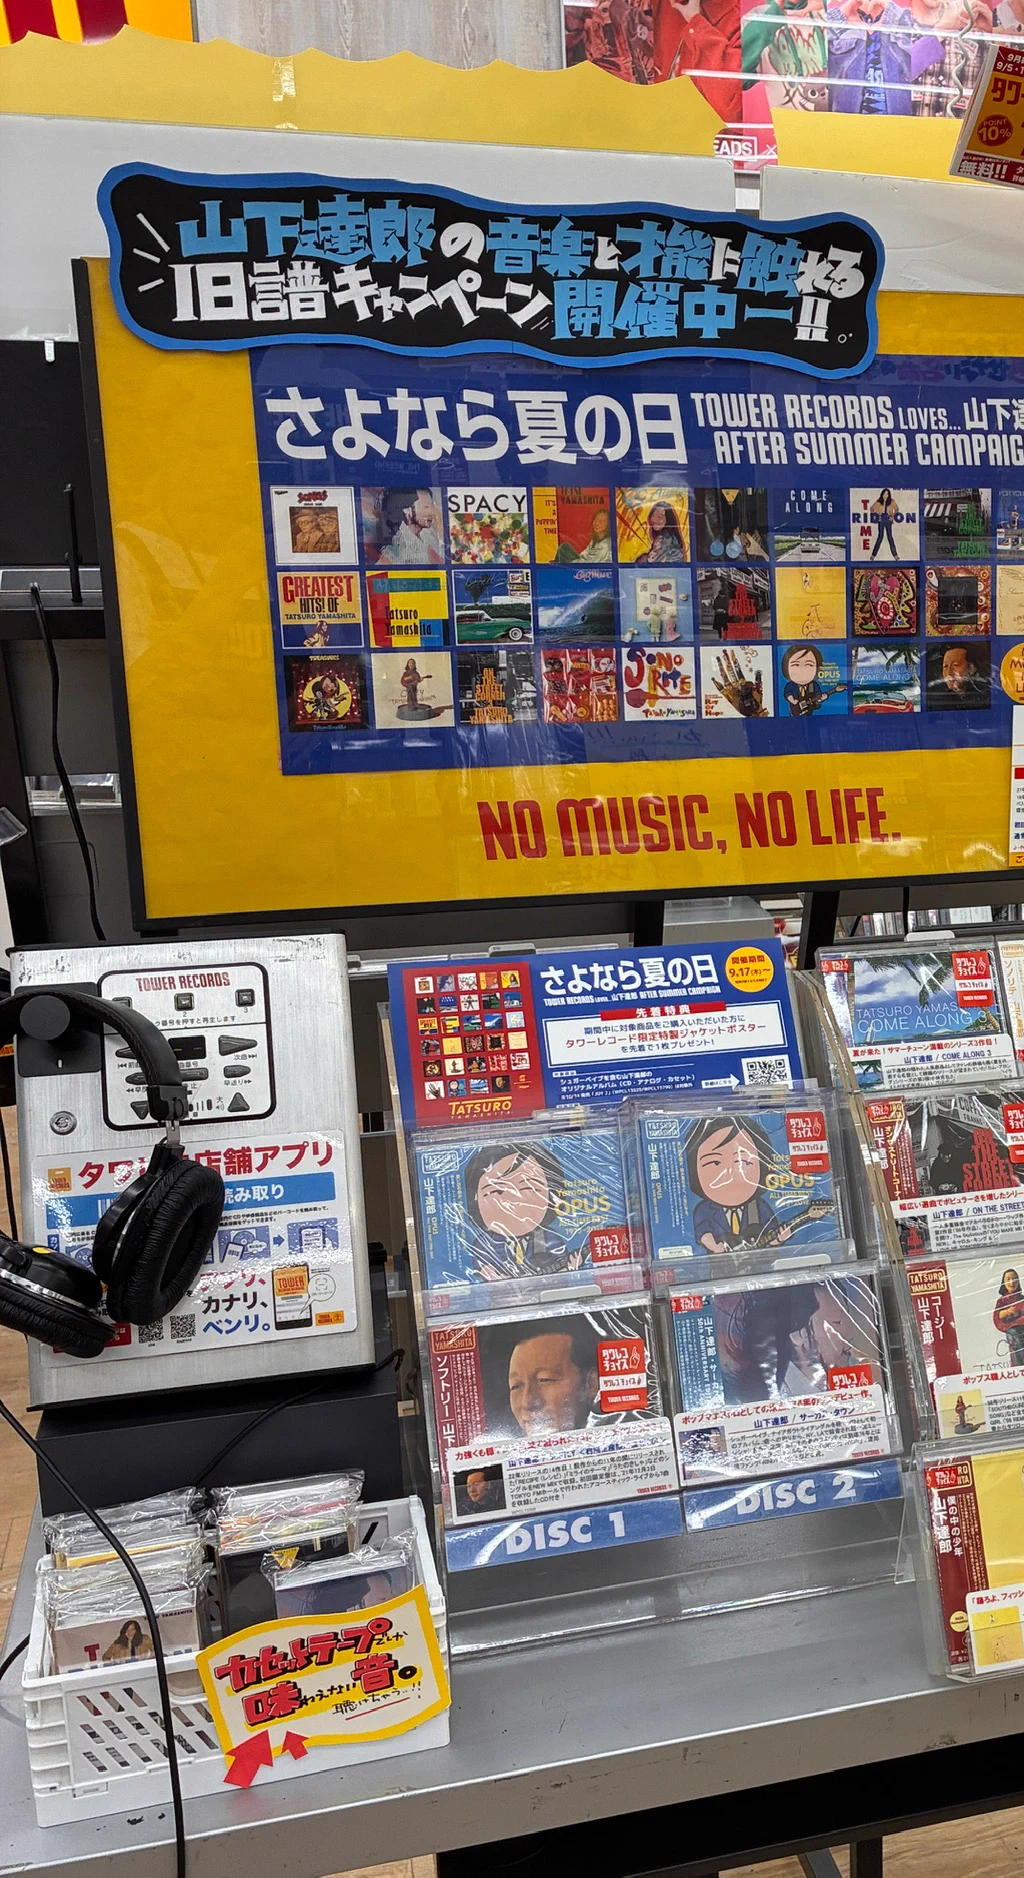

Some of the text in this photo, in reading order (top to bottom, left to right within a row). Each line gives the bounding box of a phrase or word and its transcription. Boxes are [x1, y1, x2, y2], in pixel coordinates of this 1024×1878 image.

[983, 119, 1007, 127] POINT
[979, 126, 1011, 141] 10%
[690, 392, 779, 429] TOWER
[785, 395, 894, 430] RECORDS
[265, 386, 688, 465] さよなら夏の日
[714, 431, 787, 466] AFTER
[794, 432, 909, 466] SUMMER
[448, 494, 526, 514] SPACY
[790, 489, 829, 501] COME
[785, 502, 833, 513] ALONG
[282, 575, 354, 603] GREATEST
[285, 612, 356, 620] TATSURO YAMASHITA
[818, 670, 841, 679] OPUS
[477, 787, 901, 861] NO MUSIC, NO LIFE.
[731, 955, 765, 964] 開催期間
[136, 971, 230, 992] TOWER RECORDS
[539, 954, 719, 996] さよなら夏の日
[544, 998, 566, 1007] TOWER
[566, 996, 594, 1005] RECORDS
[640, 990, 658, 1000] AFTER
[658, 988, 687, 998] SUMMER
[688, 986, 721, 996] CAMPAIGN
[635, 1004, 691, 1018] 先着特典
[856, 1005, 912, 1018] TATSURO
[584, 1015, 746, 1035] 期間中に対象商品をご購入いただいた方に
[857, 1012, 964, 1034] COME ALONG
[565, 1023, 766, 1048] タワーレコード限定特製ジャケットポスター
[621, 1039, 715, 1053] を先着で1枚プレゼント!
[904, 1055, 933, 1064] 山下達郎
[448, 1100, 512, 1116] TATSURO
[790, 1117, 812, 1129] タワレコ
[790, 1128, 813, 1140] チョイス
[555, 1196, 611, 1216] OPUS
[933, 1209, 963, 1219] 山下達郎
[985, 1205, 998, 1213] THE
[1000, 1202, 1024, 1211] STREET
[277, 1274, 305, 1289] TOWER
[202, 1291, 268, 1315] カナリ、
[202, 1313, 270, 1335] ベンリ。
[917, 1297, 935, 1344] 山下達郎
[601, 1348, 629, 1361] タワレコ
[604, 1359, 629, 1372] チョイス
[436, 1356, 450, 1417] ソフトリー
[754, 1415, 788, 1428] 山下達郎
[735, 1475, 856, 1516] DISC 2
[506, 1511, 625, 1555] DISC 1
[932, 1497, 952, 1554] 山下達郎
[947, 1495, 964, 1557] 僕の中の少年
